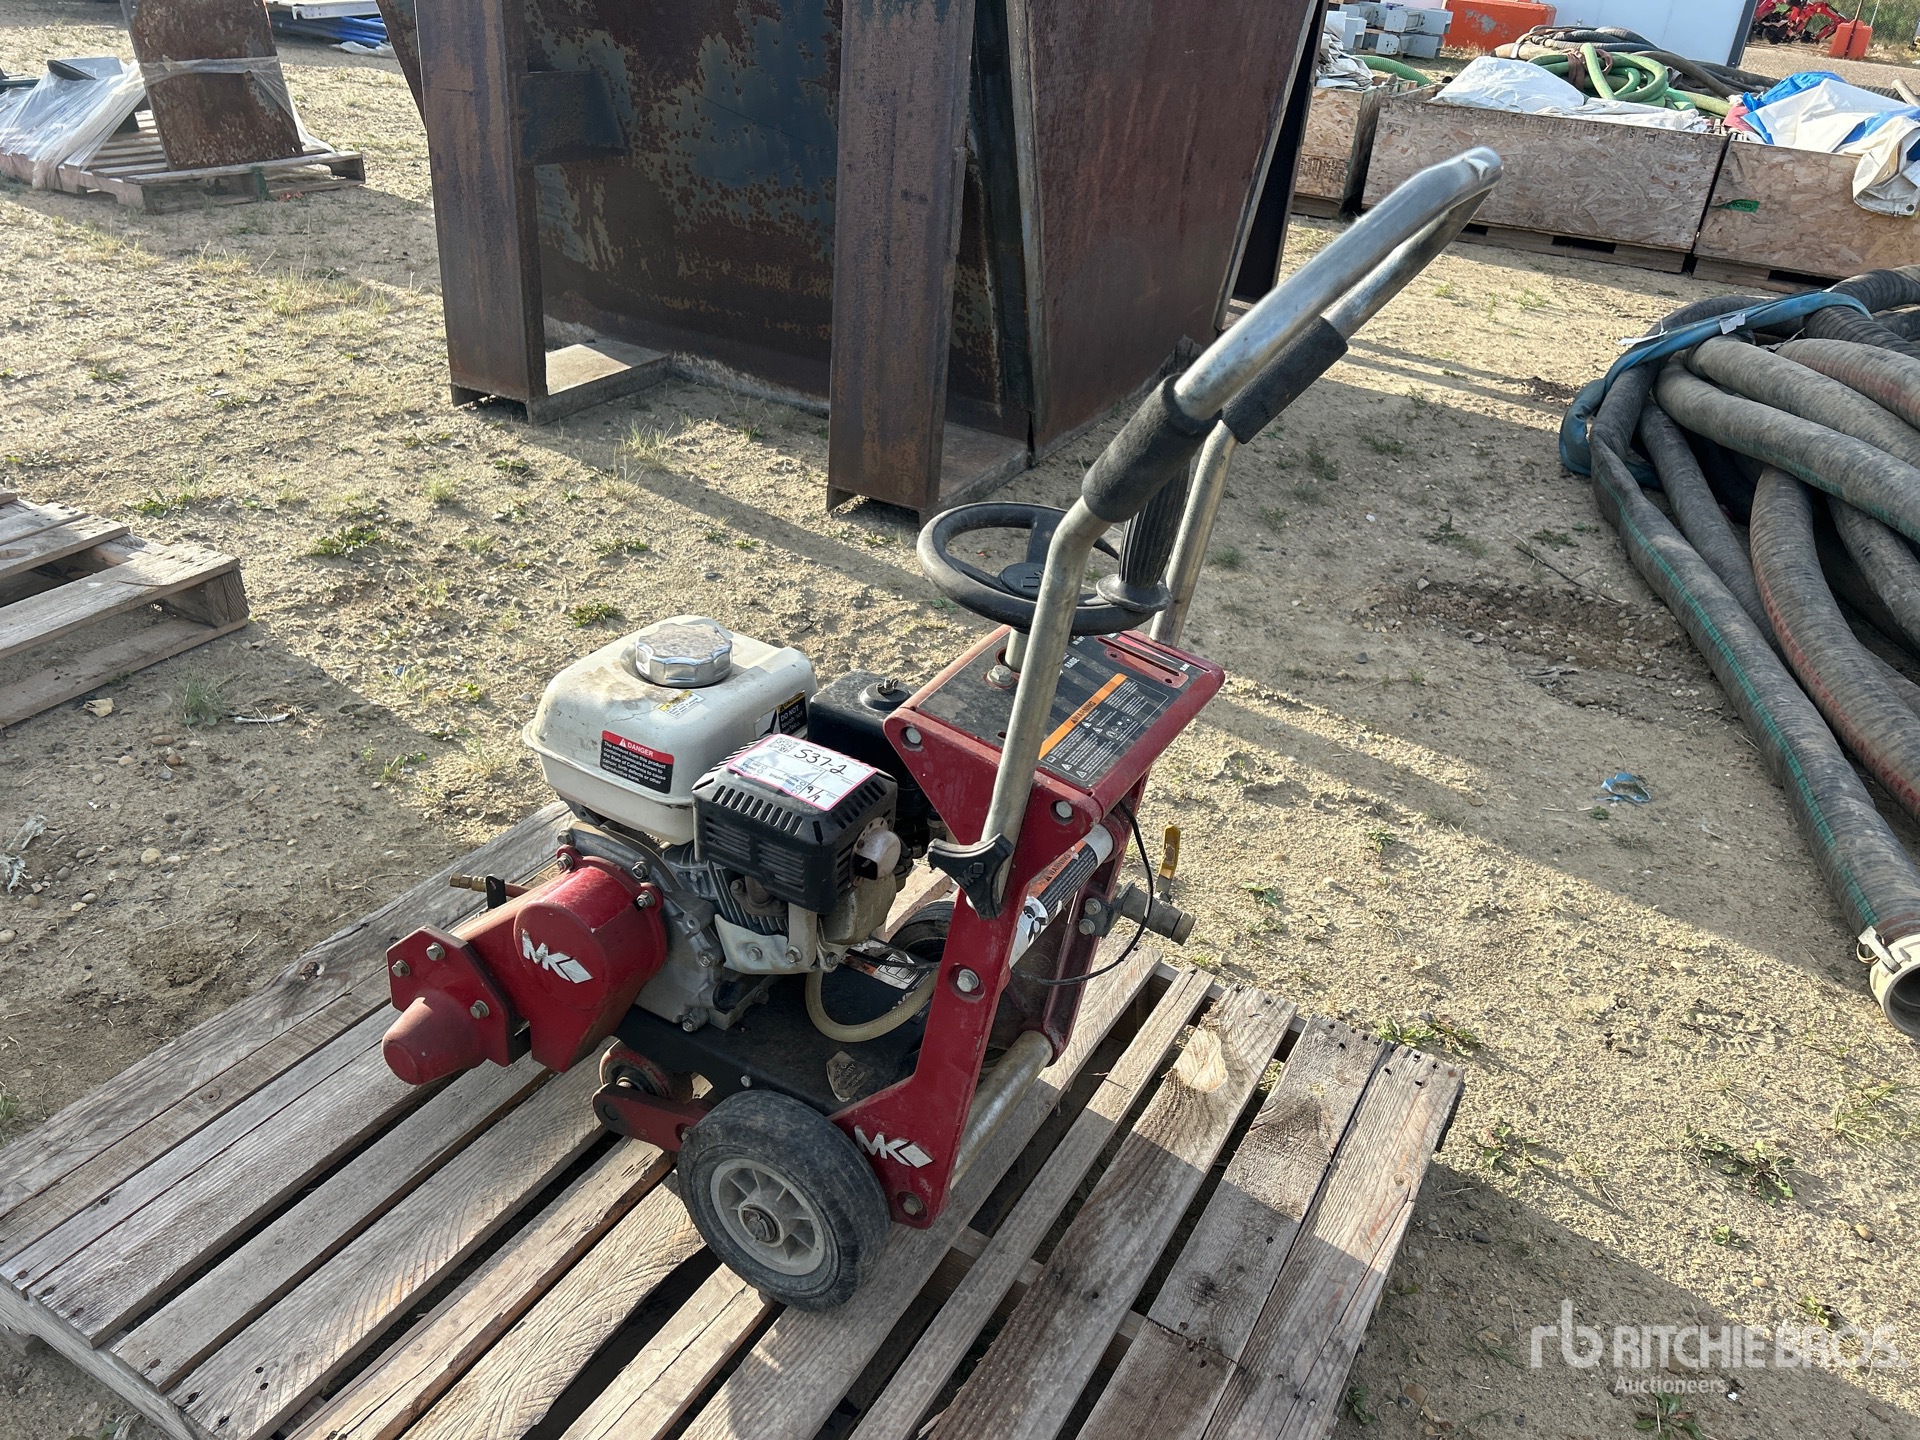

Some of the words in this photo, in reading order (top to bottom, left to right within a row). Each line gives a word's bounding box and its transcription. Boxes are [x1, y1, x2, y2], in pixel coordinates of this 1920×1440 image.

[780, 712, 788, 722] DO
[788, 704, 799, 716] NOT
[603, 747, 621, 758] contains
[621, 754, 642, 767] chemicals
[642, 763, 657, 772] known
[612, 744, 628, 755] exhaust
[629, 750, 639, 759] from
[639, 754, 647, 763] this
[647, 758, 666, 770] product
[627, 741, 654, 758] DANGER
[602, 763, 628, 778] reproductive
[611, 755, 621, 763] State
[626, 761, 647, 774] California
[652, 772, 666, 781] cause
[618, 763, 628, 772] birth
[628, 767, 644, 778] defects
[649, 776, 661, 785] other
[1049, 853, 1072, 876] WARNING
[522, 928, 571, 981] MK
[854, 1125, 912, 1166] MK
